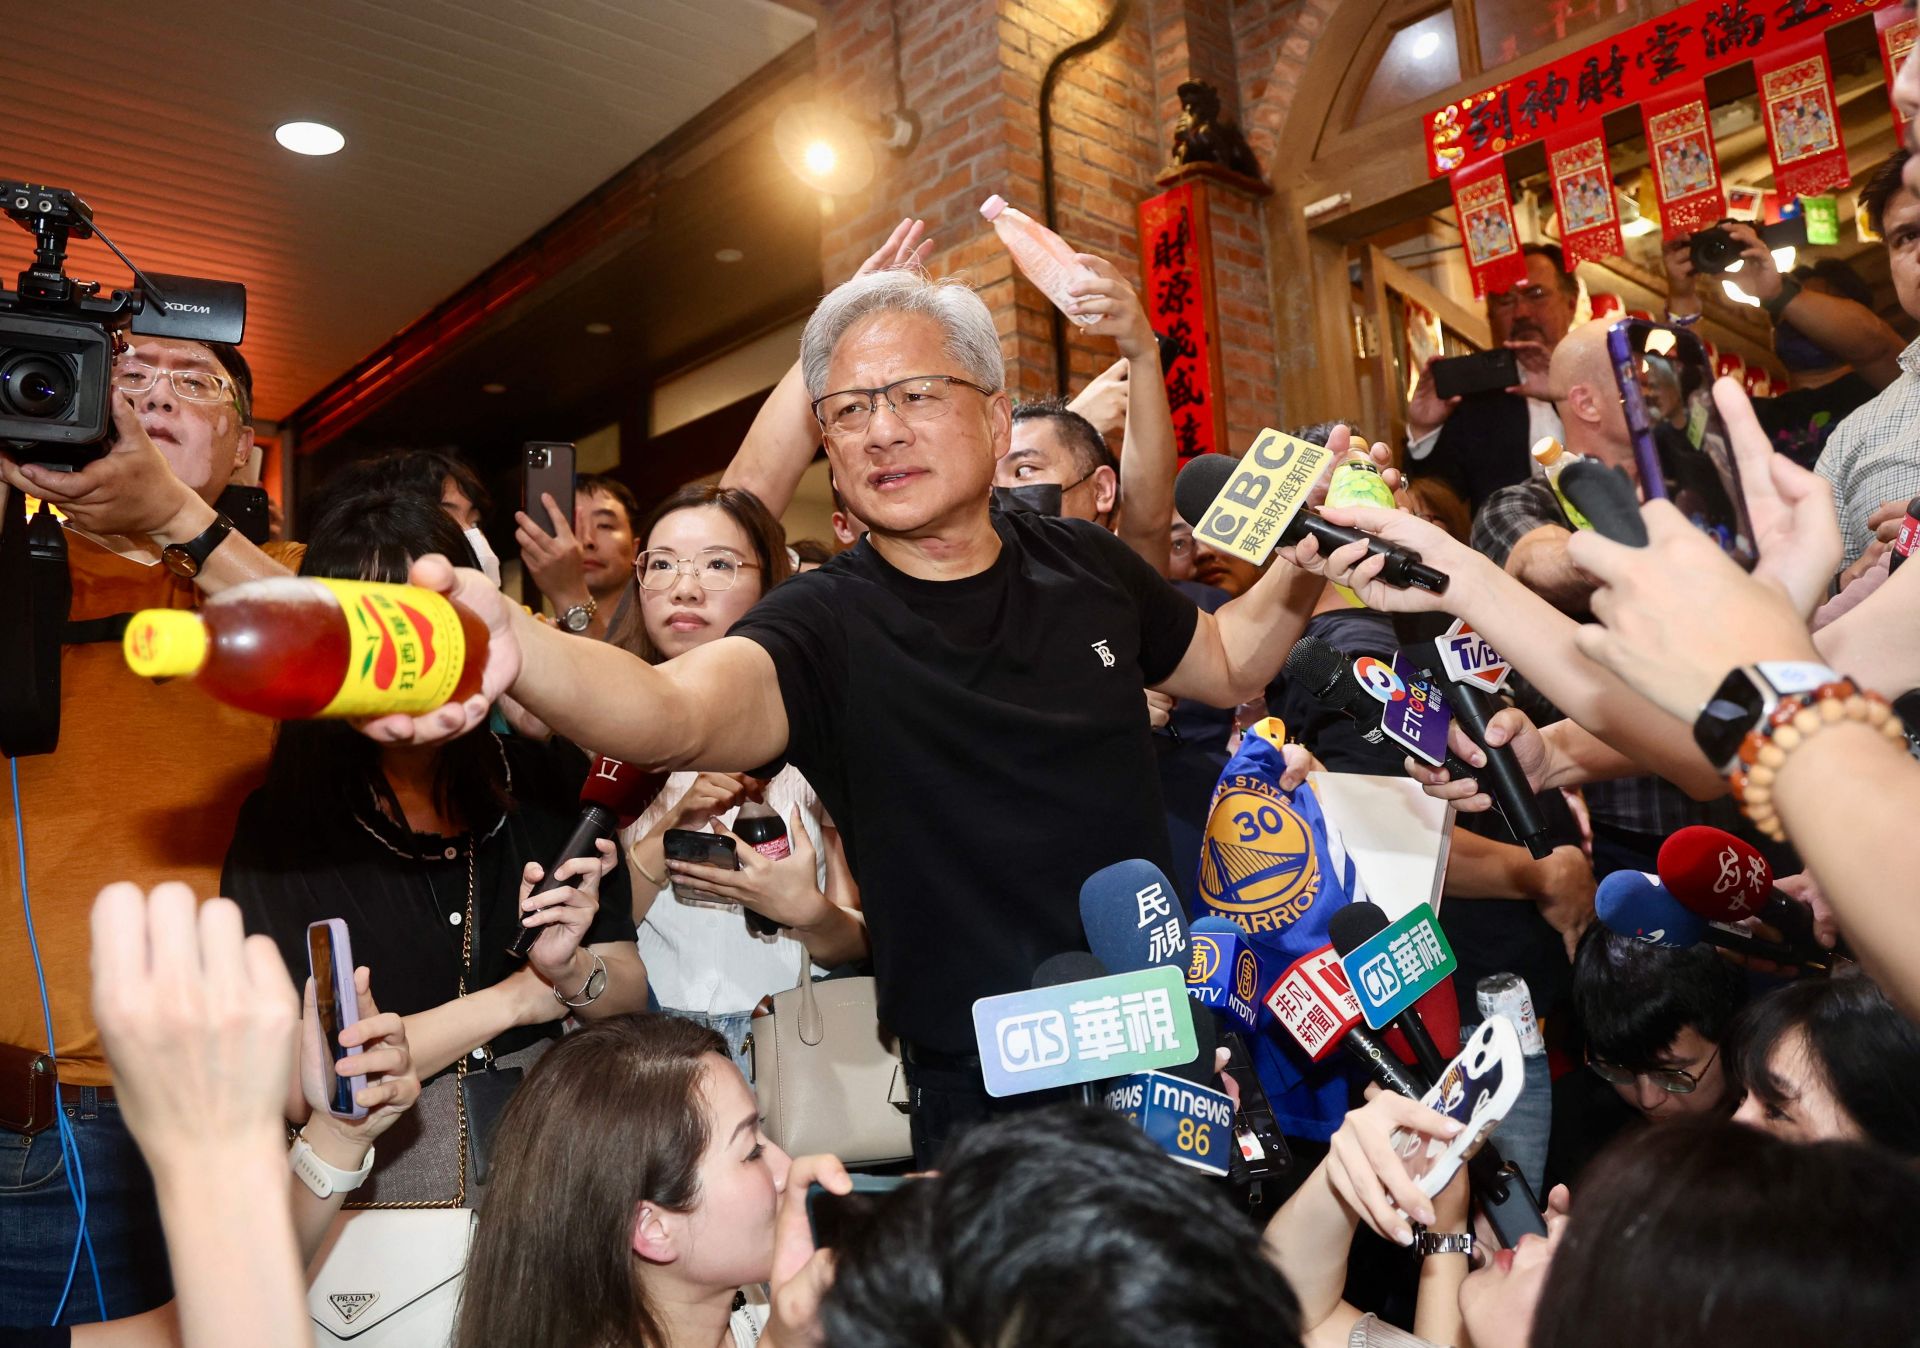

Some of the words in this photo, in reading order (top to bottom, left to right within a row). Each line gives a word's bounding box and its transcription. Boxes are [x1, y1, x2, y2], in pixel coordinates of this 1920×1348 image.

[164, 301, 210, 314] XDCAM
[1239, 447, 1325, 556] 東森財經新聞
[1232, 805, 1283, 842] 30
[1135, 882, 1186, 964] 民視
[1363, 955, 1399, 1003] CTS
[1388, 919, 1447, 987] 華視
[1002, 1016, 1064, 1066] CTS
[1069, 987, 1181, 1061] 華視
[1228, 992, 1257, 1026] NTDTV
[1296, 1003, 1335, 1048] 新聞
[1153, 1082, 1231, 1127] mnews
[1177, 1117, 1211, 1156] 86
